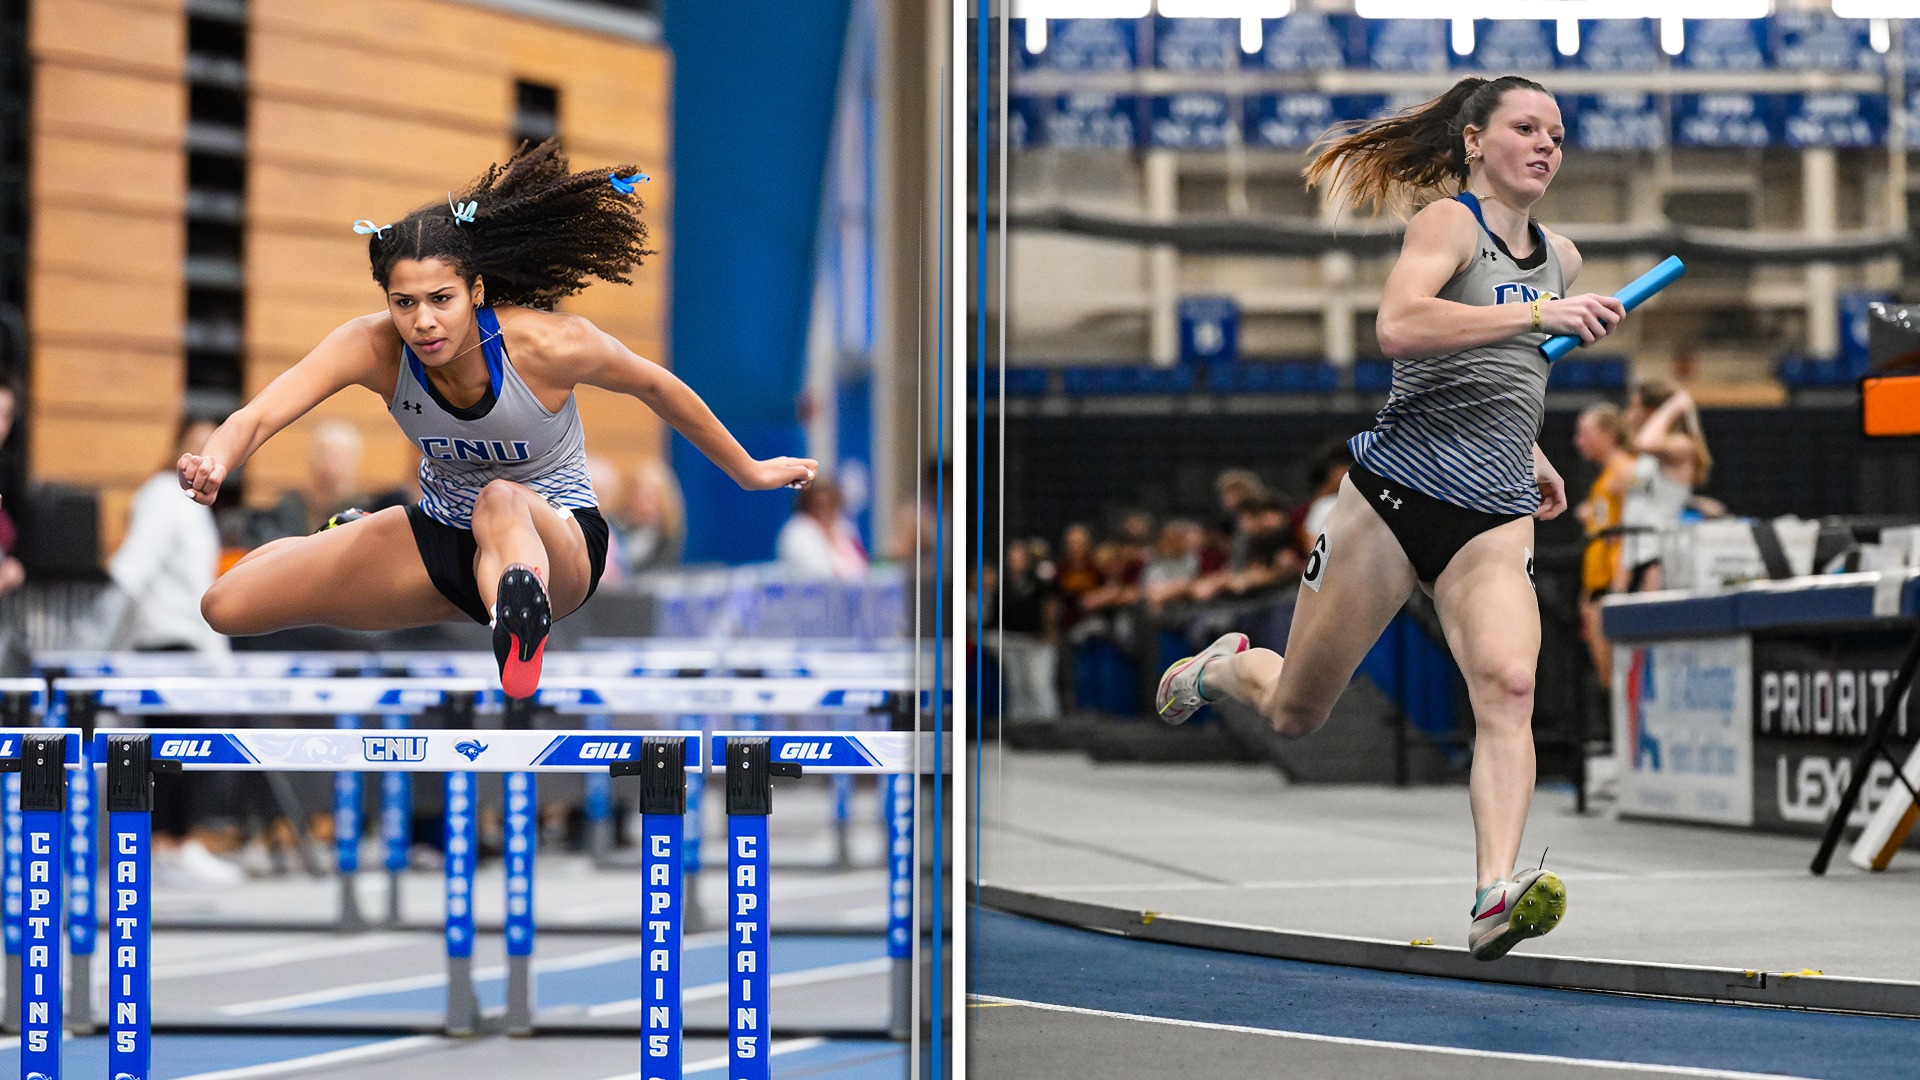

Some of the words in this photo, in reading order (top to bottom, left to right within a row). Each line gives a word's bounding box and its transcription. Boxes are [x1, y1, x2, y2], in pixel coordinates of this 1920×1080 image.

[418, 436, 530, 463] CNU
[1303, 533, 1326, 582] 6
[159, 739, 212, 757] GILL
[362, 736, 429, 763] CNU
[578, 742, 632, 759] GILL
[779, 742, 833, 760] GILL
[29, 832, 50, 1053] CAPTAINS
[116, 832, 138, 1053] CAPTAINS
[649, 835, 671, 1057] CAPTAINS
[736, 836, 758, 1059] CAPTAINS
